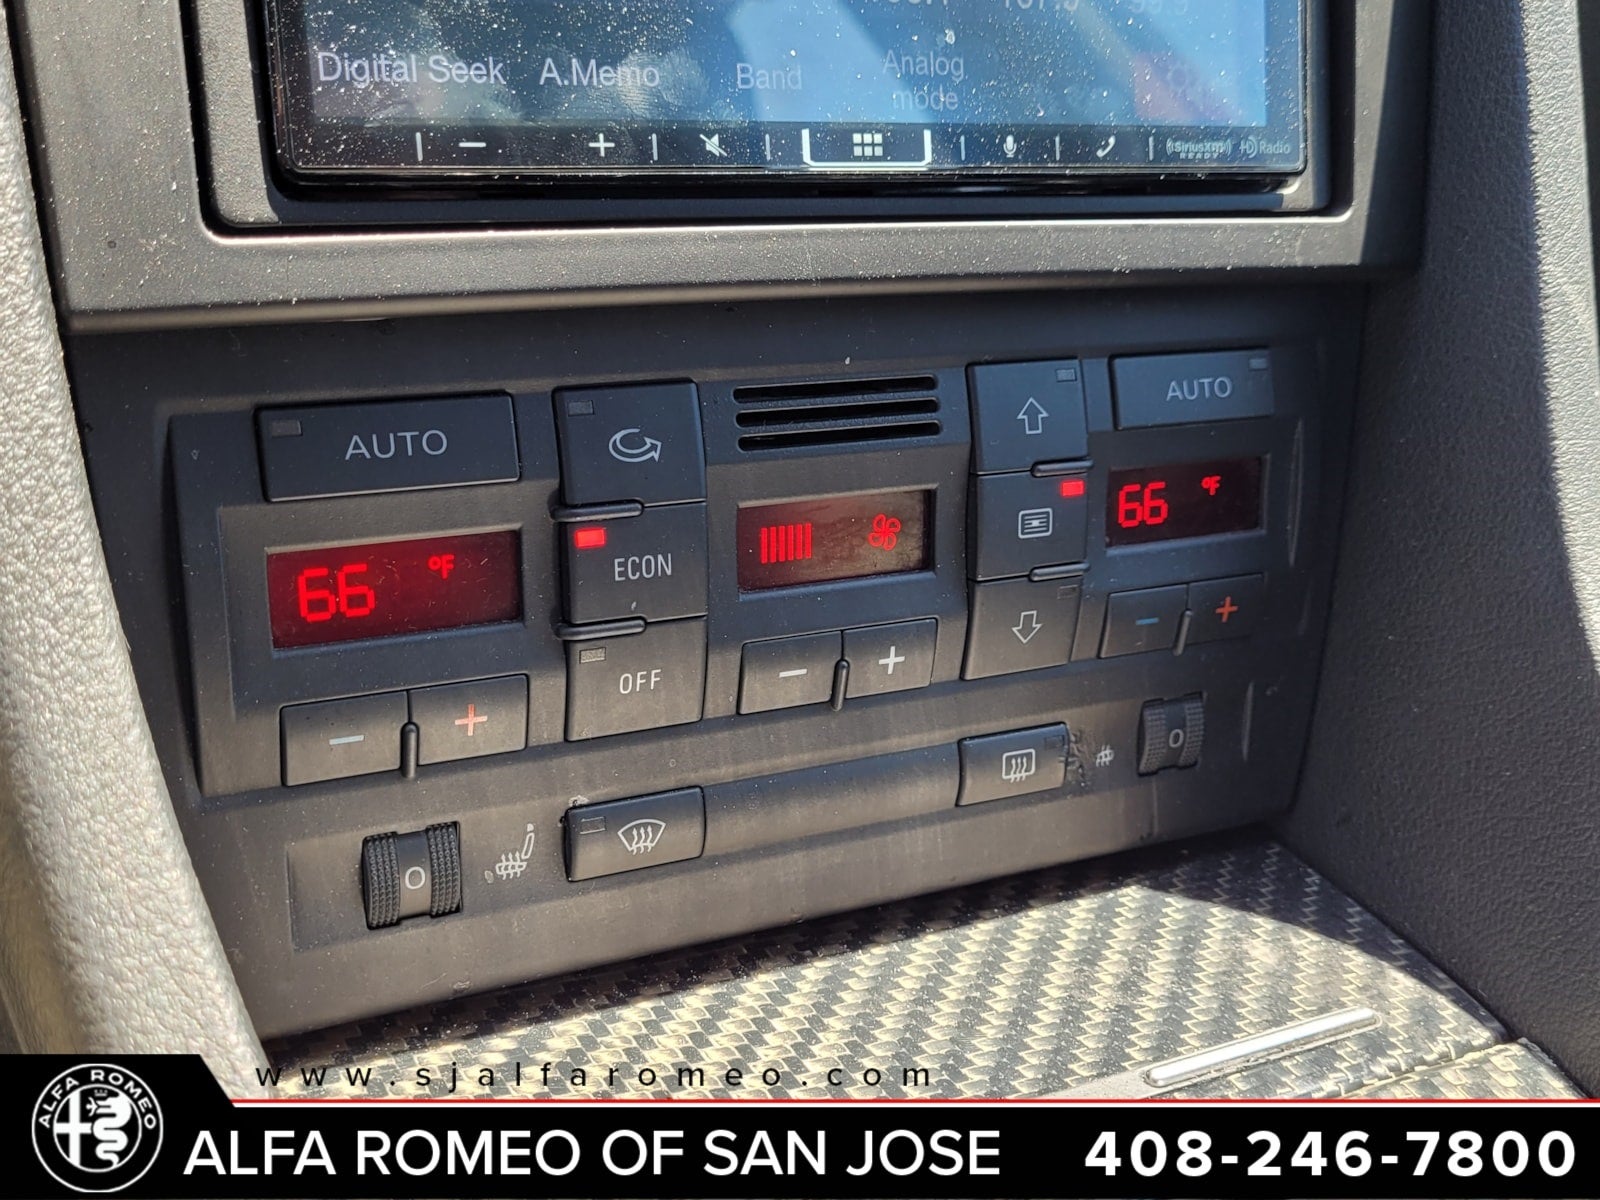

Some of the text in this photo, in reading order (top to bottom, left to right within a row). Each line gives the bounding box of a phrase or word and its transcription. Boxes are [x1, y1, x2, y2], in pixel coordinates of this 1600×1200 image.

[318, 52, 803, 91] Digital Seek A.Memo Band
[882, 48, 965, 84] Analog
[893, 84, 959, 111] mode
[1260, 140, 1291, 155] Radio
[1166, 376, 1232, 402] AUTO
[344, 429, 448, 461] AUTO
[1117, 481, 1170, 529] 66
[614, 552, 673, 582] ECON
[298, 563, 375, 623] 66
[619, 668, 662, 695] OFF
